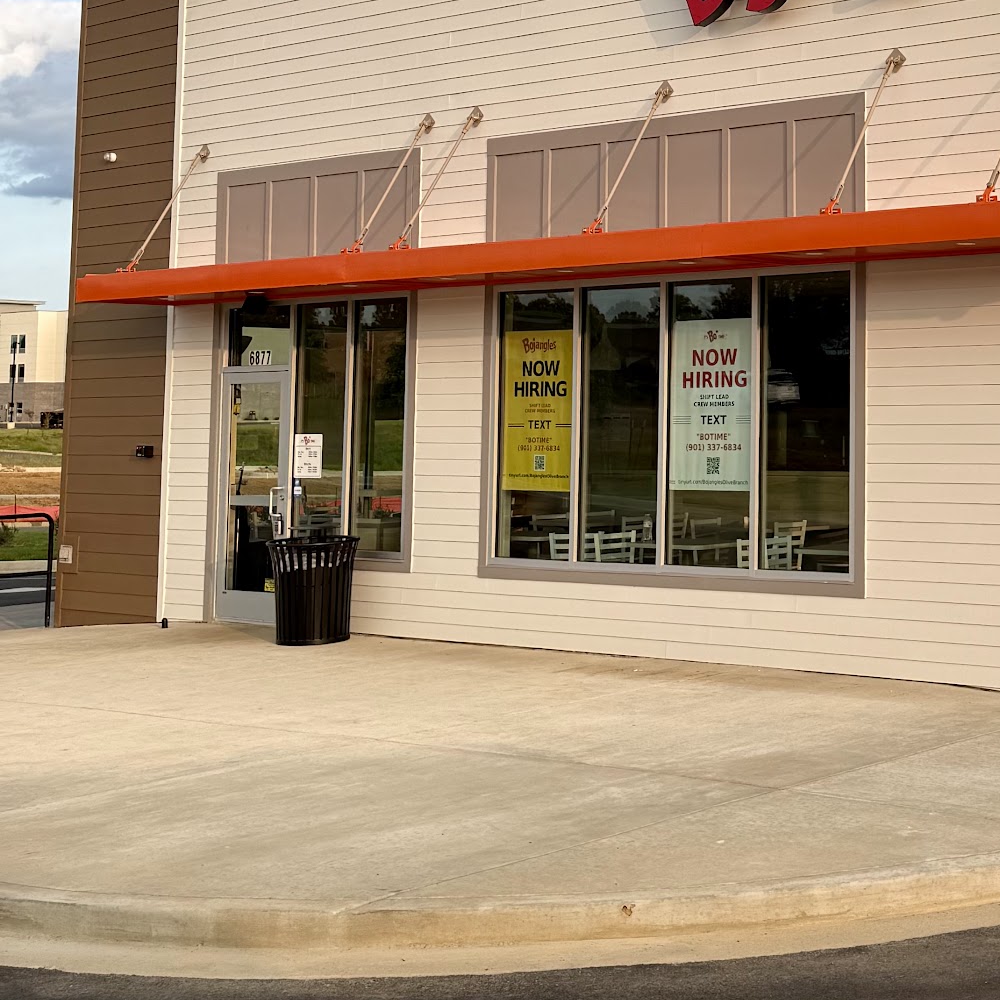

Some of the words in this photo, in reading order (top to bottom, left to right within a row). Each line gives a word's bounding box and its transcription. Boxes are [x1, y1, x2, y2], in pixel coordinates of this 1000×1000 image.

[522, 337, 556, 353] Bojangles
[249, 350, 271, 365] 6877
[692, 348, 737, 366] NOW
[523, 360, 560, 376] NOW
[682, 370, 747, 388] HIRING
[514, 381, 567, 397] HIRING
[528, 420, 551, 429] TEXT
[701, 415, 727, 424] TEXT
[685, 443, 705, 452] (901)
[707, 443, 742, 451] 337-6834
